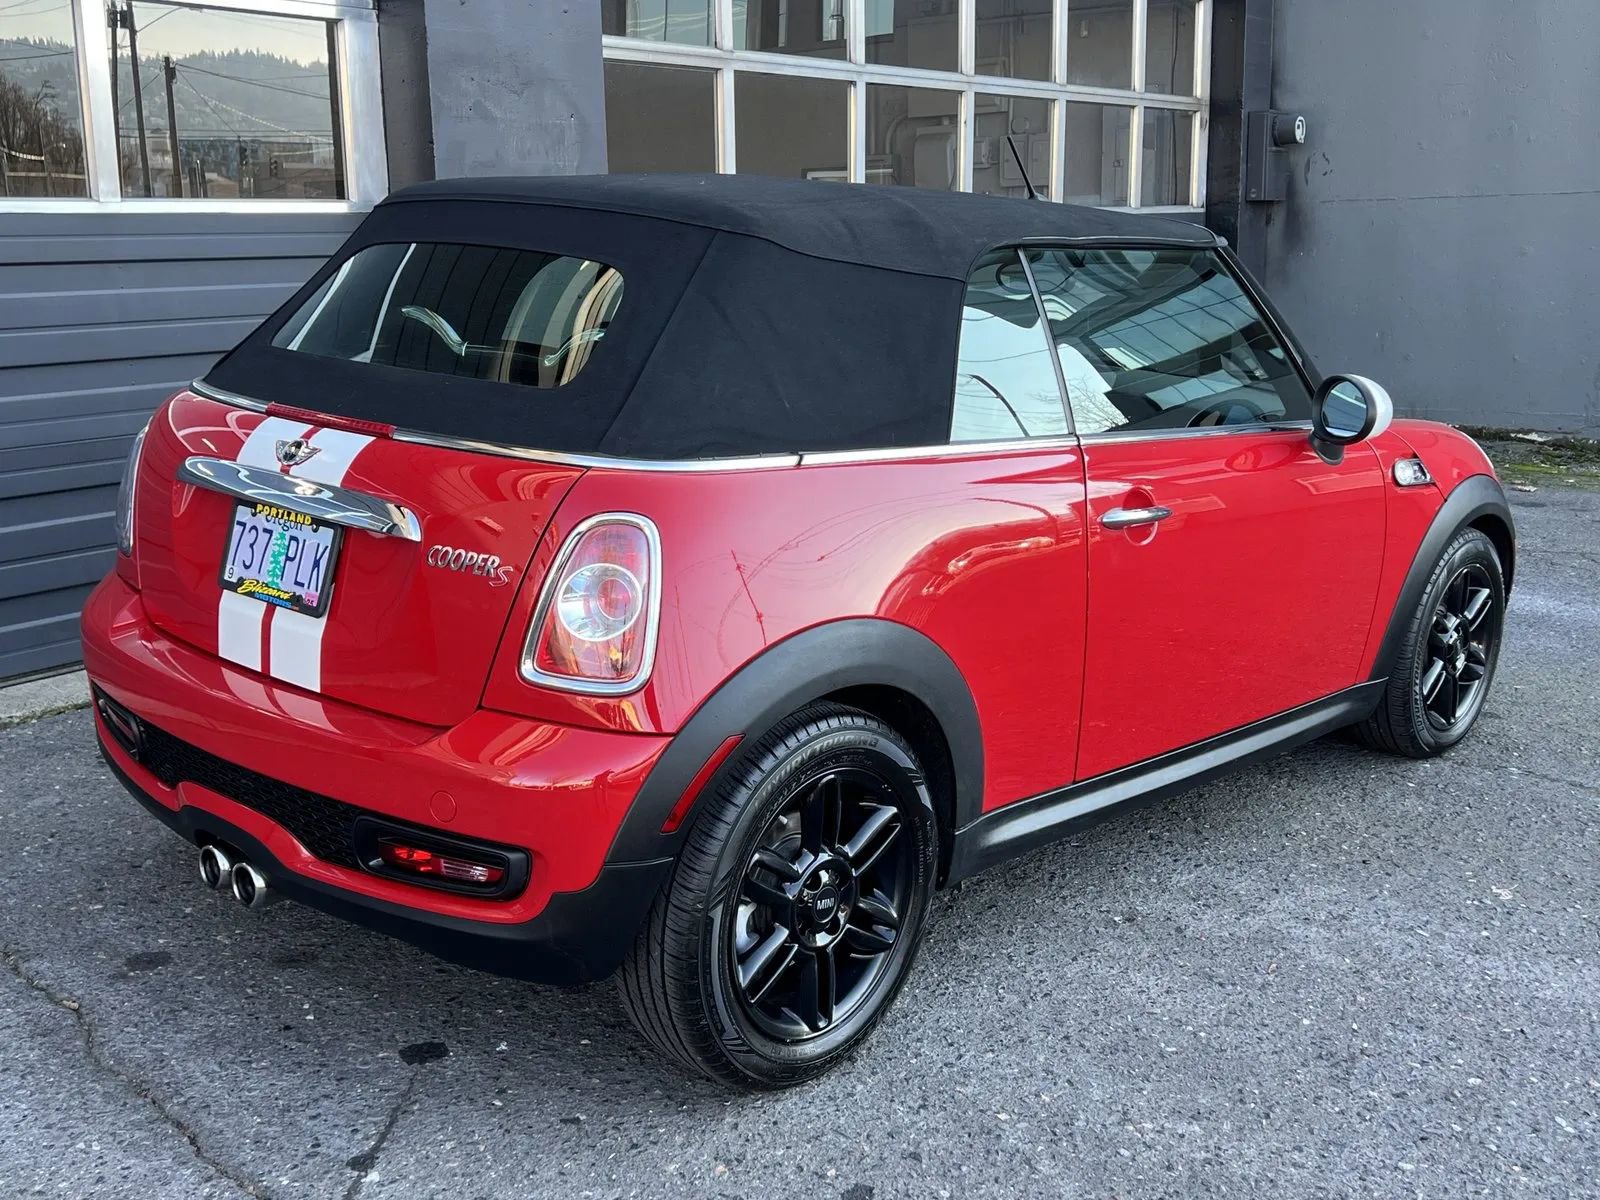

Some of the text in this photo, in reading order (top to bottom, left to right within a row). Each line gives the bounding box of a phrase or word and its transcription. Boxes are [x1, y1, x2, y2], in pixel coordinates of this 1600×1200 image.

[256, 504, 312, 525] PORTLAND
[232, 520, 329, 593] 737 PLK
[427, 545, 513, 587] COOPER S
[236, 579, 293, 600] Blizzard
[817, 897, 835, 910] MINI
